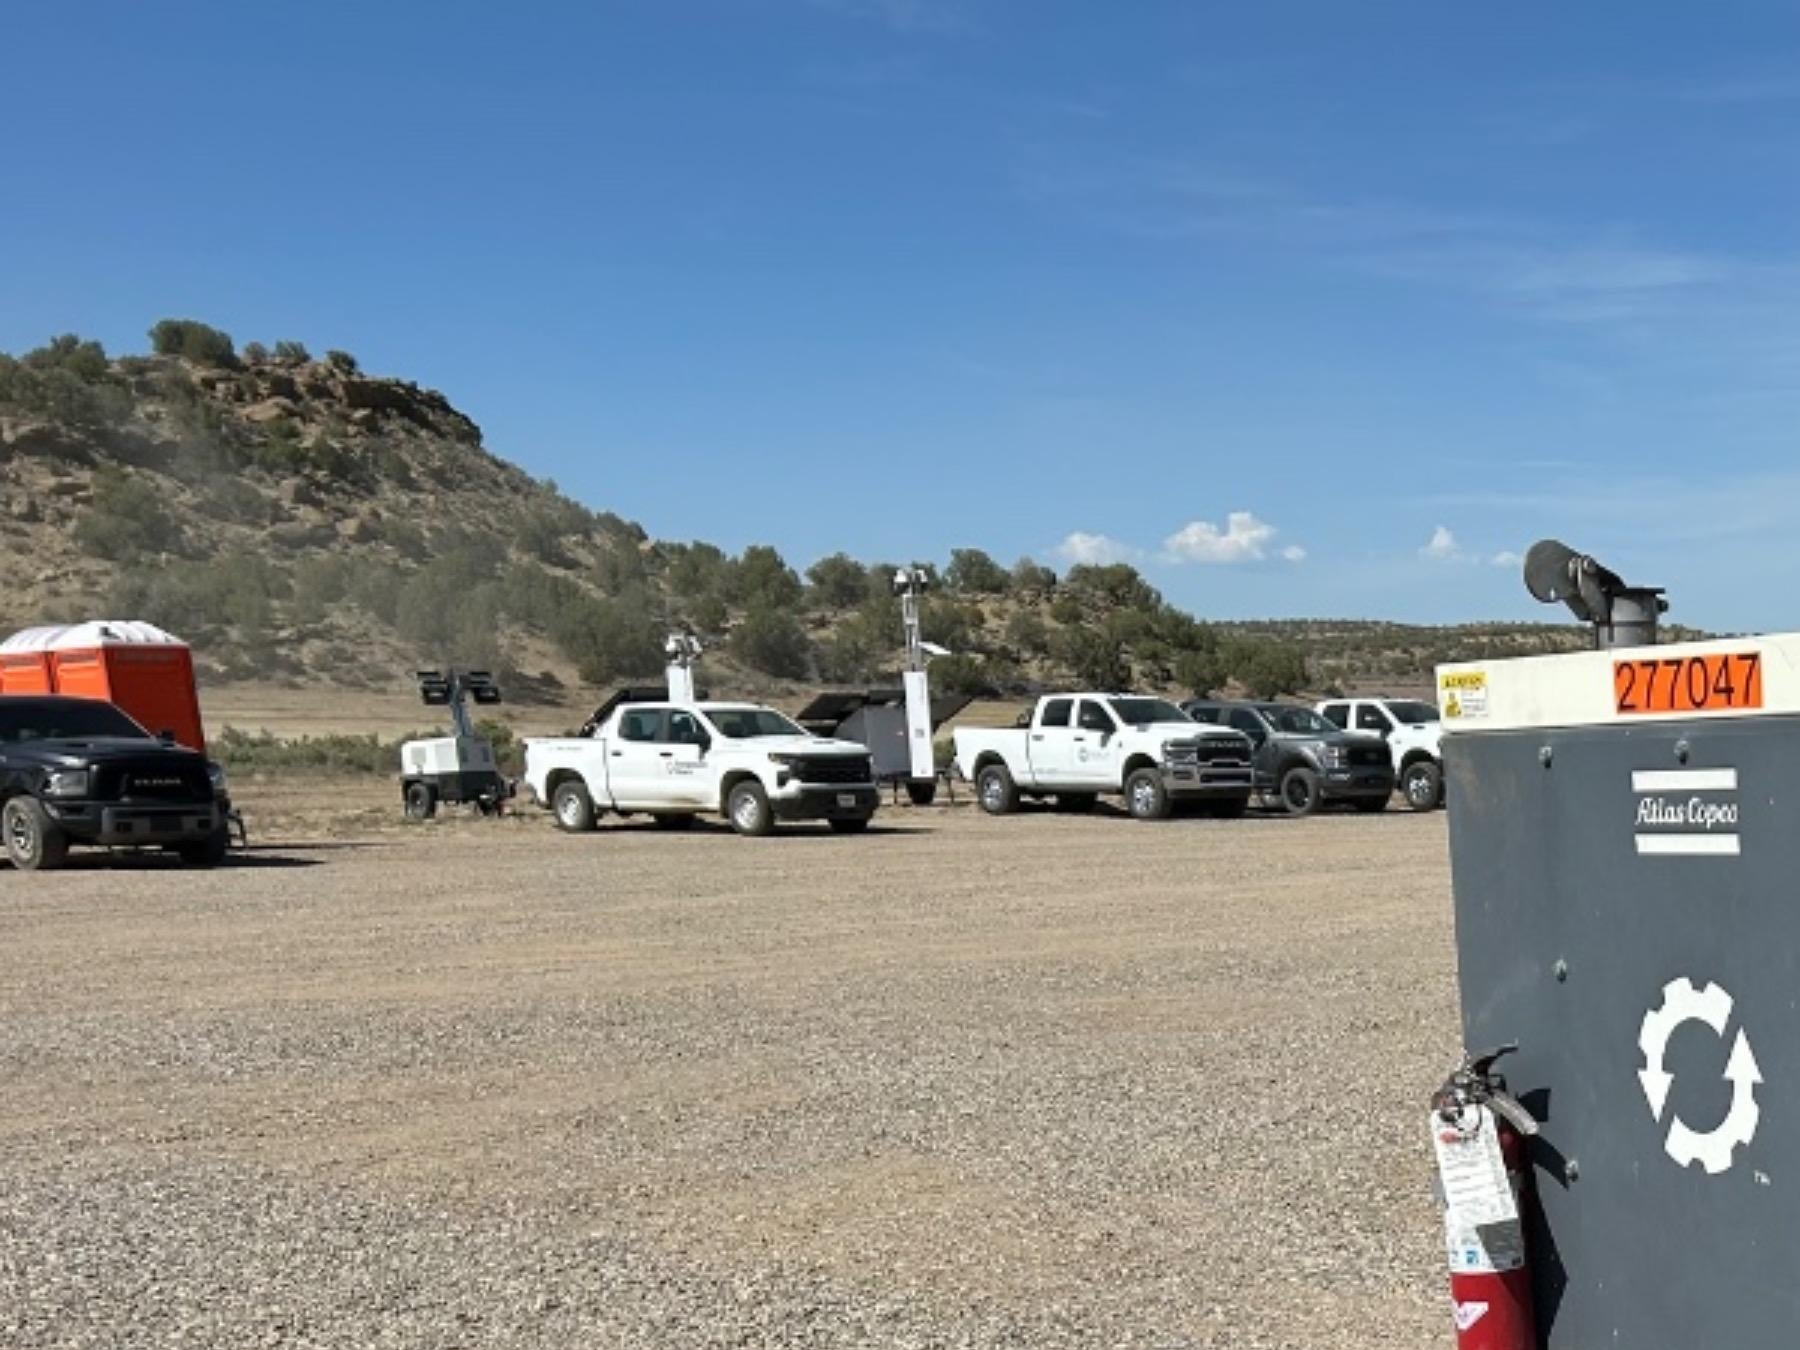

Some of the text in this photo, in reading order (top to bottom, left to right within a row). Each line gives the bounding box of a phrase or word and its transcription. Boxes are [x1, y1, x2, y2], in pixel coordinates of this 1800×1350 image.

[1616, 653, 1760, 712] 277047
[1634, 797, 1739, 830] Atlas Copco
